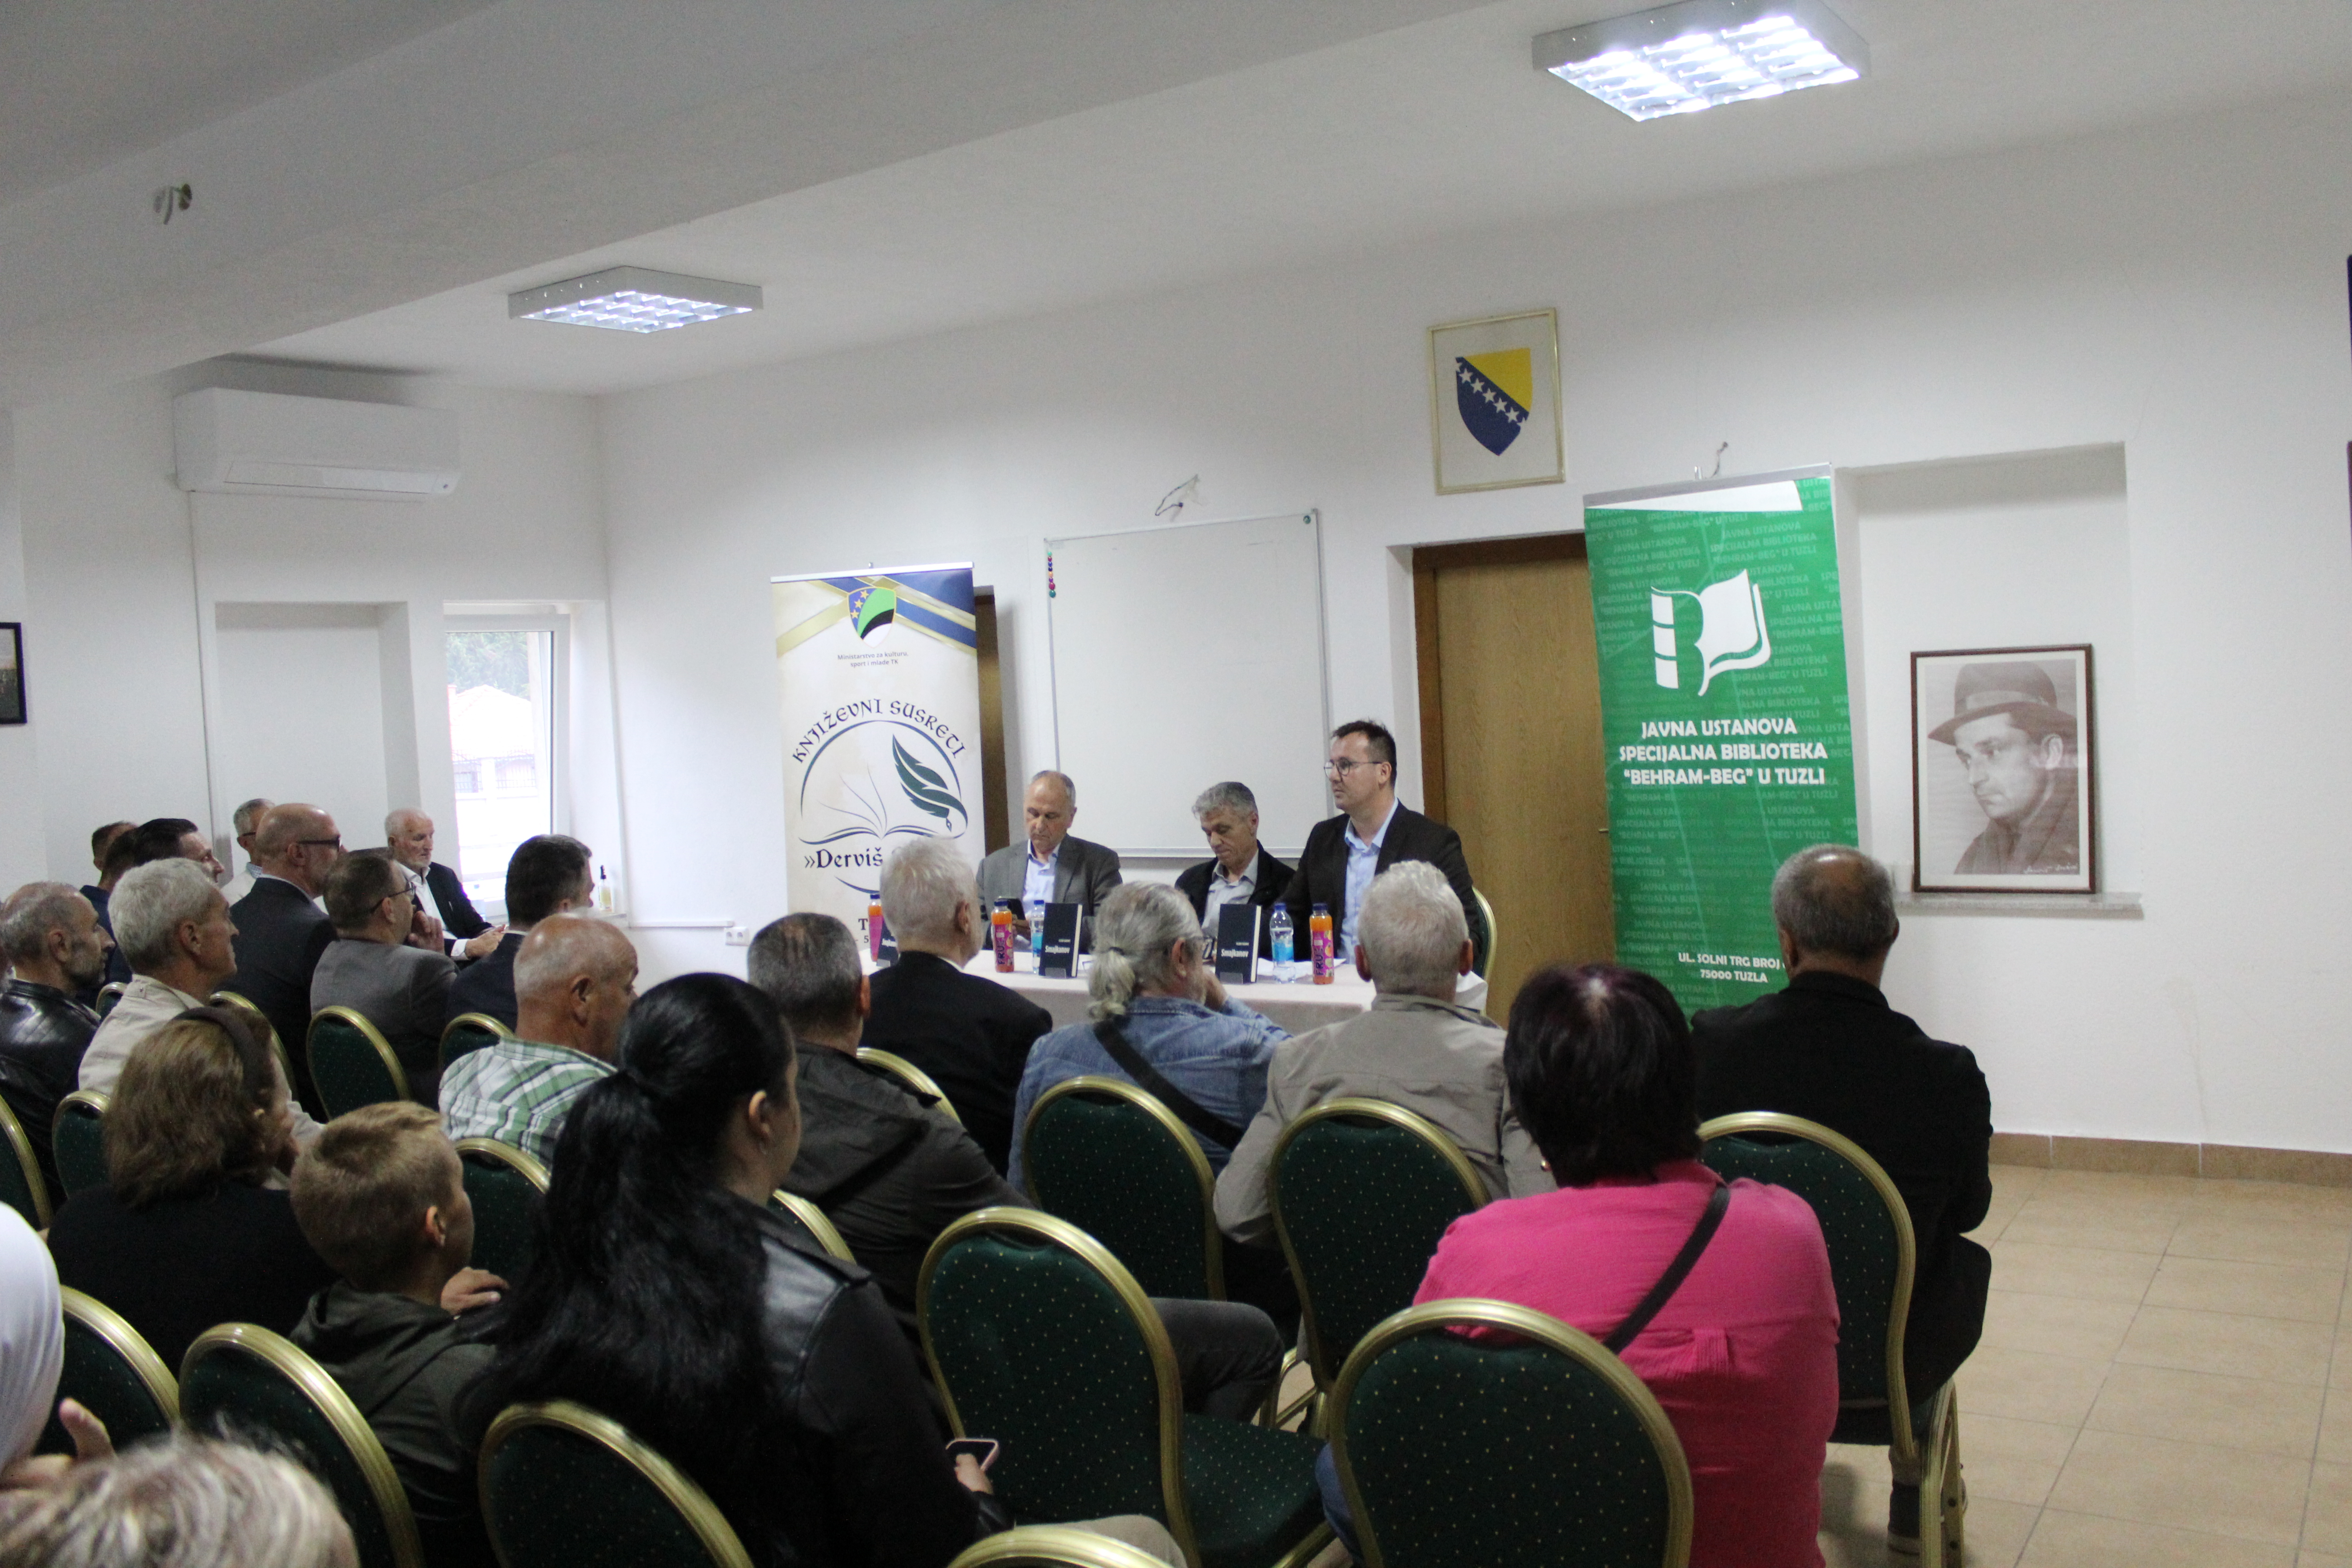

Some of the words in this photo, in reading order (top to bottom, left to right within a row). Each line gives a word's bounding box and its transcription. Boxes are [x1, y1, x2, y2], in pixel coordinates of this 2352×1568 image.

[792, 698, 882, 764] KNJIŽEVNI
[890, 700, 965, 759] SUSRETI
[1642, 721, 1698, 739] JAVNA
[1702, 718, 1798, 736] USTANOVA
[1619, 744, 1717, 762] SPECIJALNA
[1720, 742, 1828, 760] BIBLIOTEKA
[1758, 768, 1770, 784] U
[1774, 767, 1825, 785] TUZLI
[1678, 952, 1695, 963] UL.
[1697, 953, 1727, 965] SOLNI
[1729, 956, 1751, 967] TRG
[1752, 957, 1780, 970] BROJ
[1700, 969, 1732, 980] 75000
[1734, 970, 1769, 983] TUZLA
